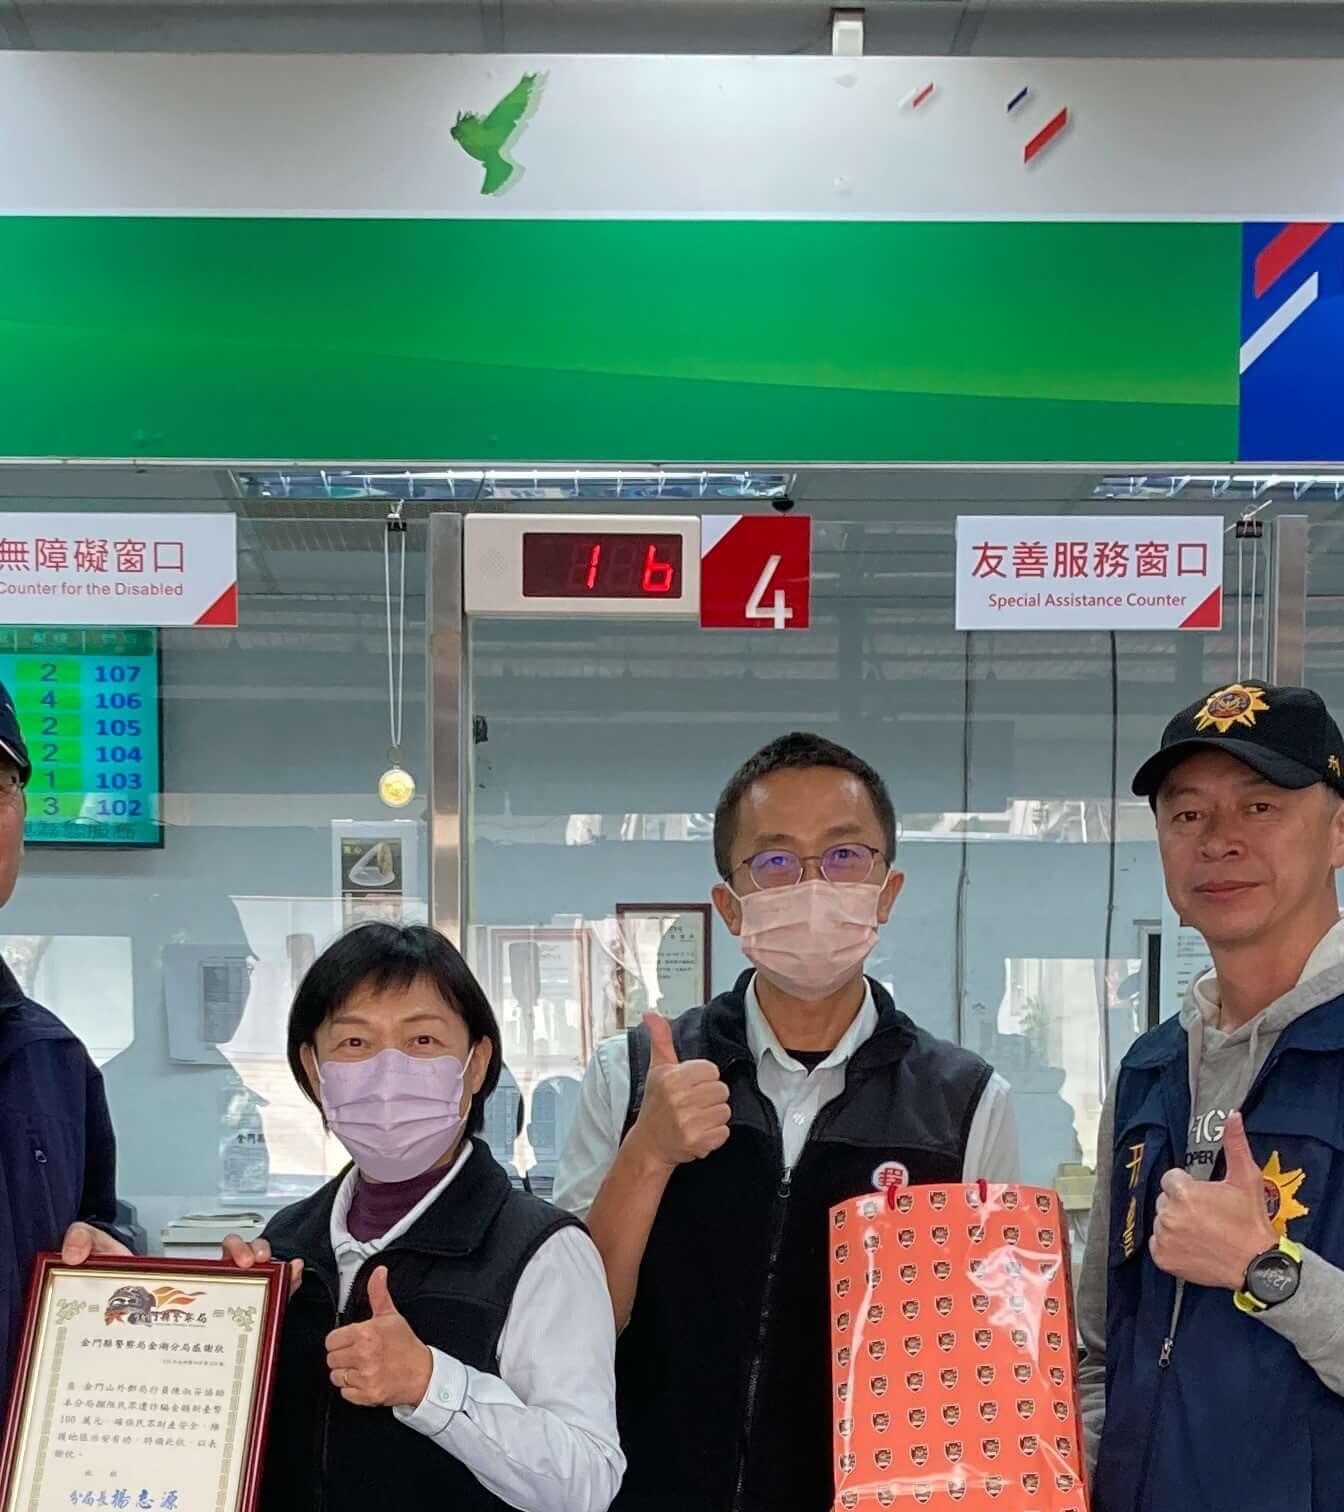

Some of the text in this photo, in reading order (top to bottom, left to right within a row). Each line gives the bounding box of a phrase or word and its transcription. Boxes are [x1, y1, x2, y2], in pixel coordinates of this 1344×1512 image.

[971, 541, 1209, 579] 友善服務窗口
[61, 581, 81, 597] for
[86, 581, 109, 597] the
[113, 581, 184, 597] Disabled
[746, 555, 794, 629] 4
[988, 592, 1187, 611] Special Assistance Counter
[40, 663, 142, 684] 2 107
[40, 690, 142, 710] 4 106
[40, 717, 143, 737] 2 105
[40, 744, 144, 764] 2 104
[44, 770, 144, 790] 1 103
[42, 797, 143, 817] 3 102
